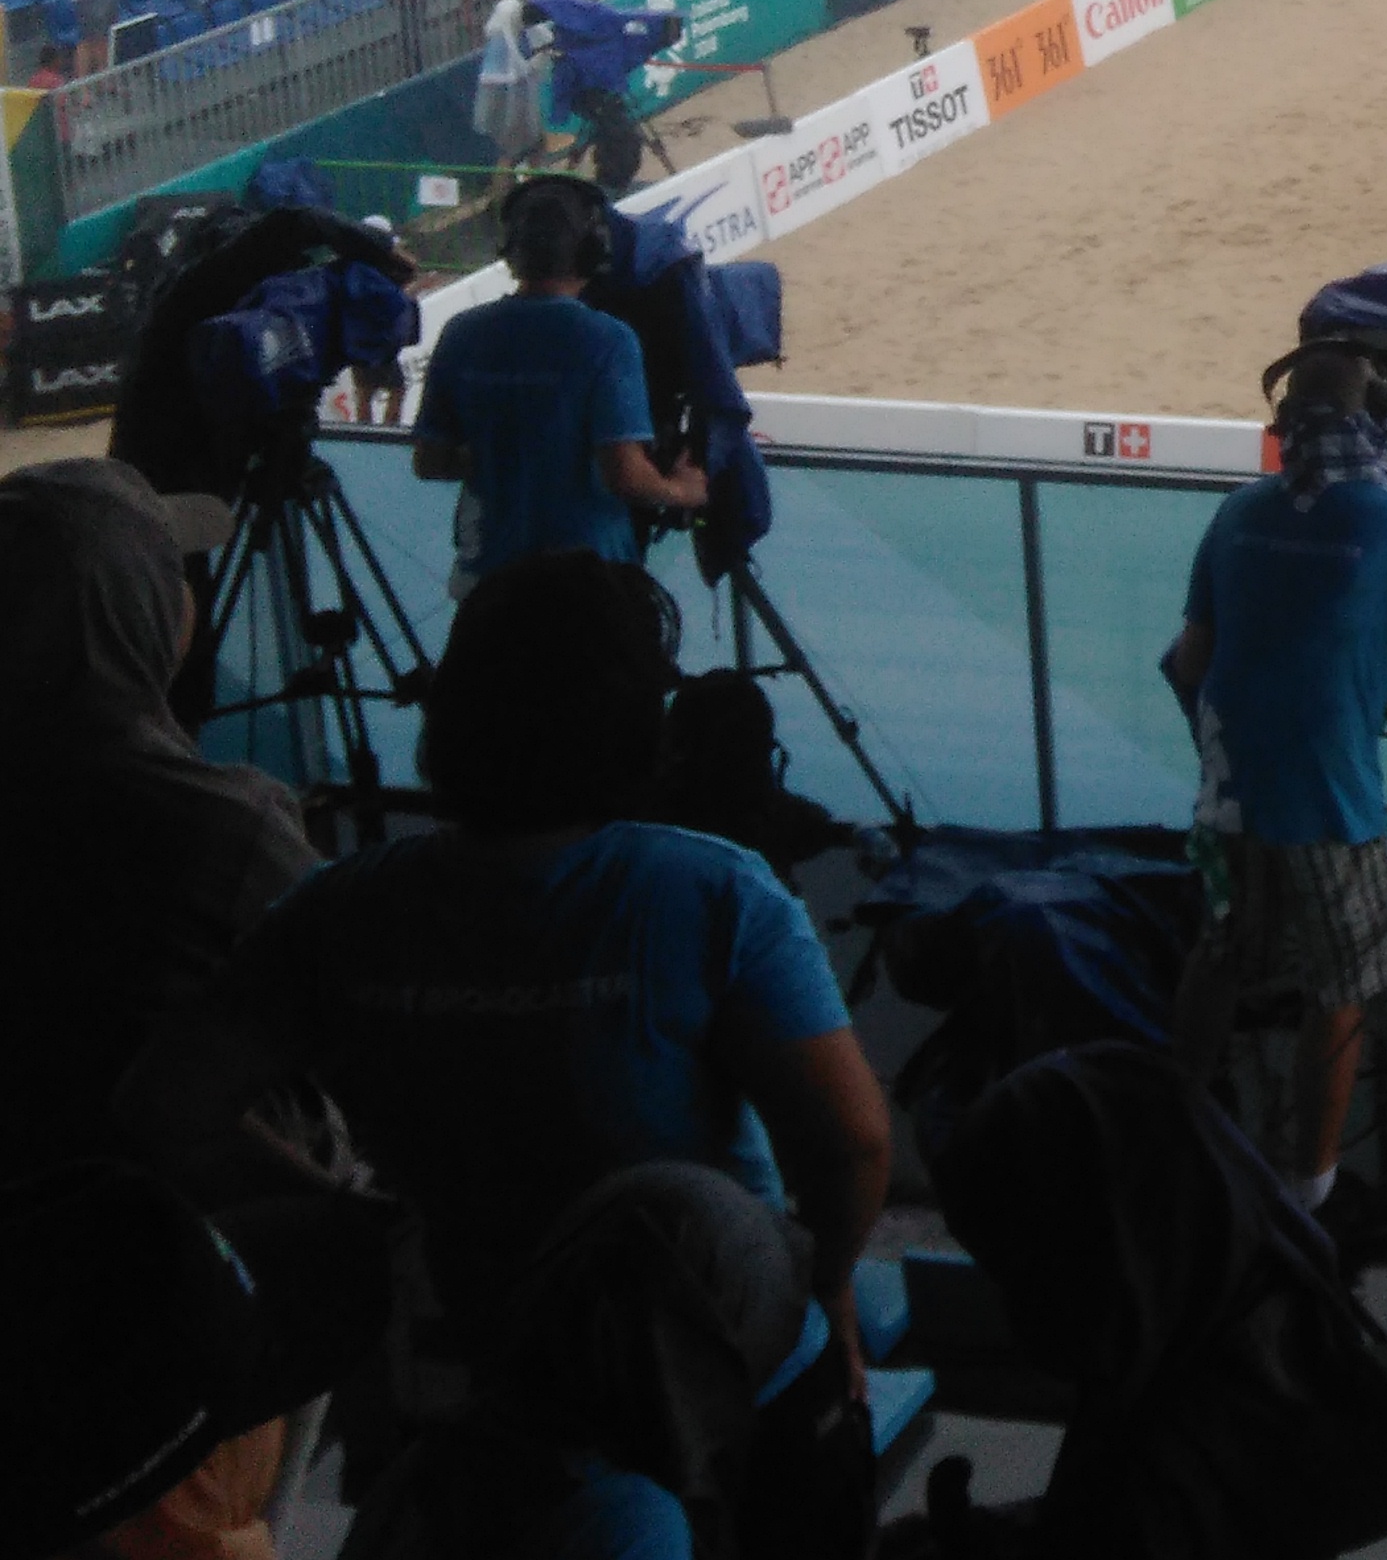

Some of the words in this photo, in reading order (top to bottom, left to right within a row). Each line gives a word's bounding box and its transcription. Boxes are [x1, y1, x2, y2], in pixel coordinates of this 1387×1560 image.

[889, 84, 969, 149] TISSOT
[789, 149, 817, 182] APP
[843, 123, 869, 153] APP
